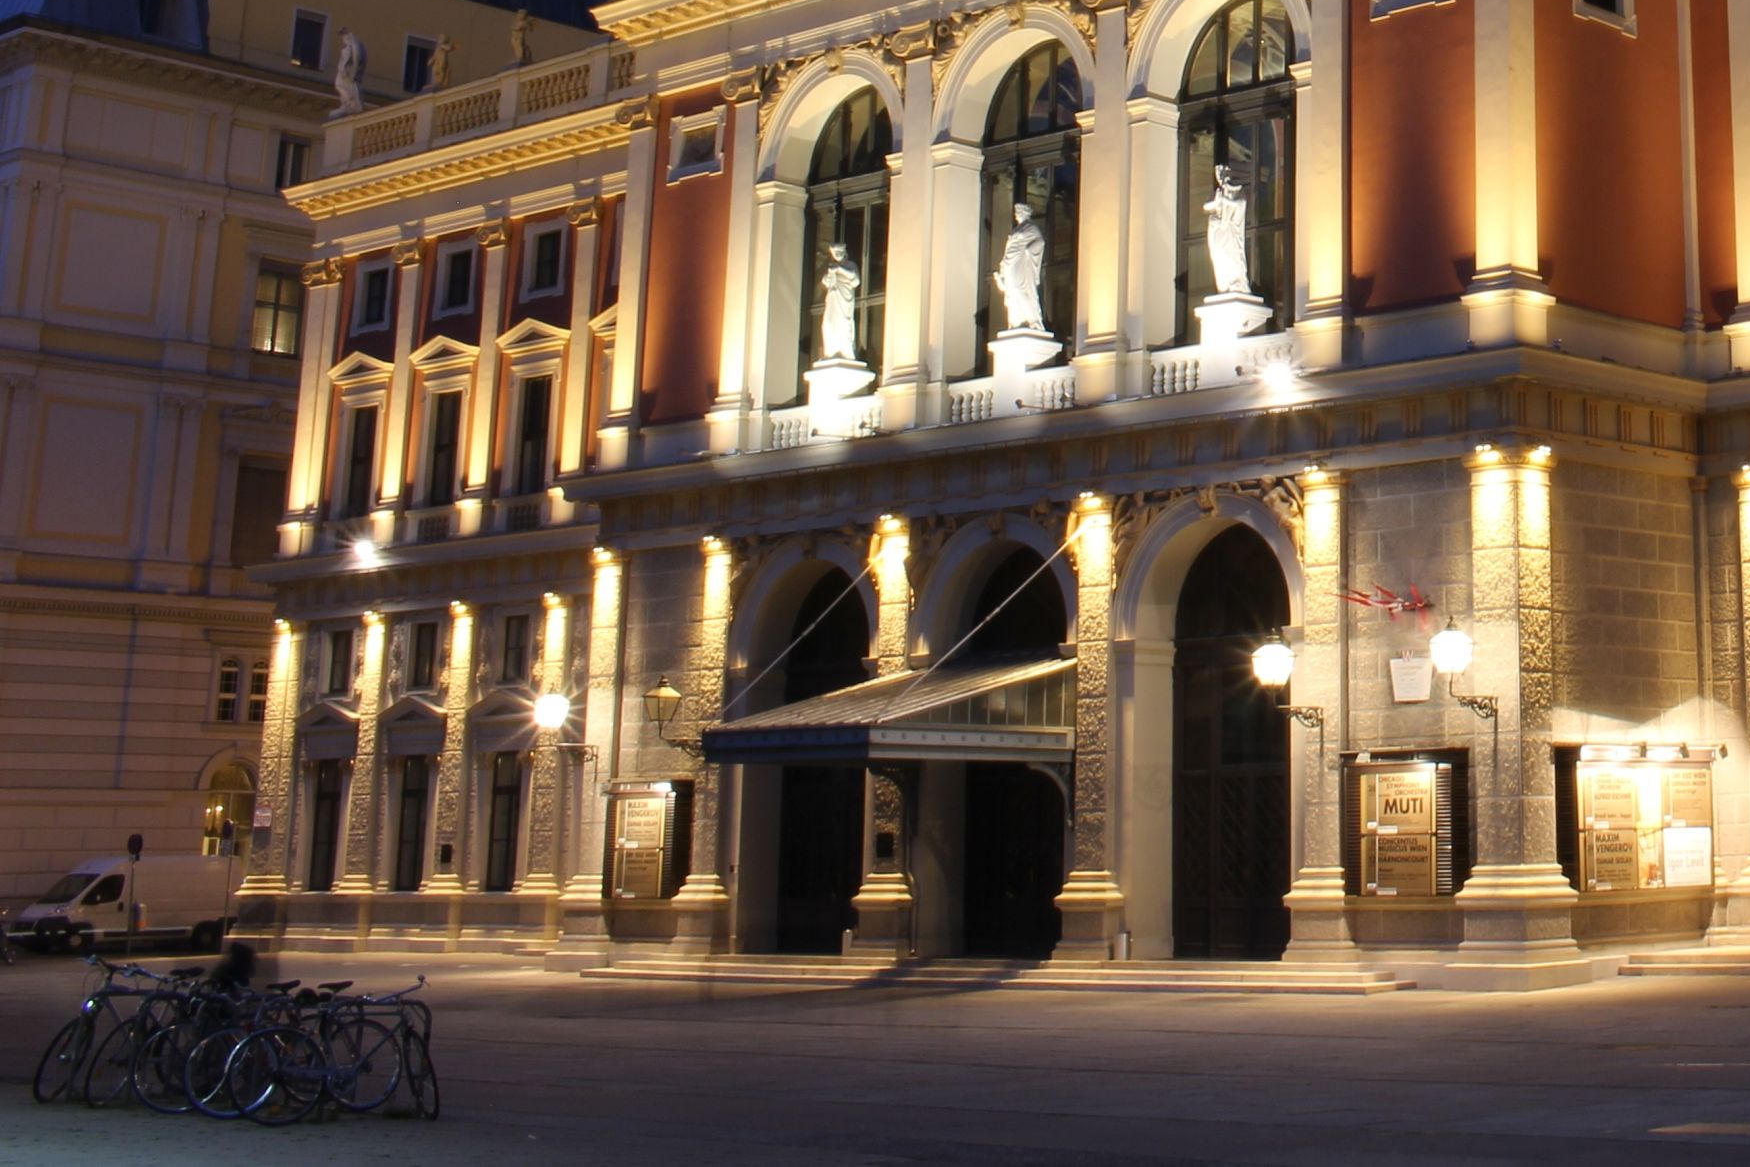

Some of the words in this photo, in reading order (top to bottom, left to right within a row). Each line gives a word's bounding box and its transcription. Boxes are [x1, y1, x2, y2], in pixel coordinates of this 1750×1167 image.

[1384, 798, 1423, 814] MUTI
[1595, 834, 1619, 842] MAXIM
[1596, 843, 1633, 852] VENGEROV
